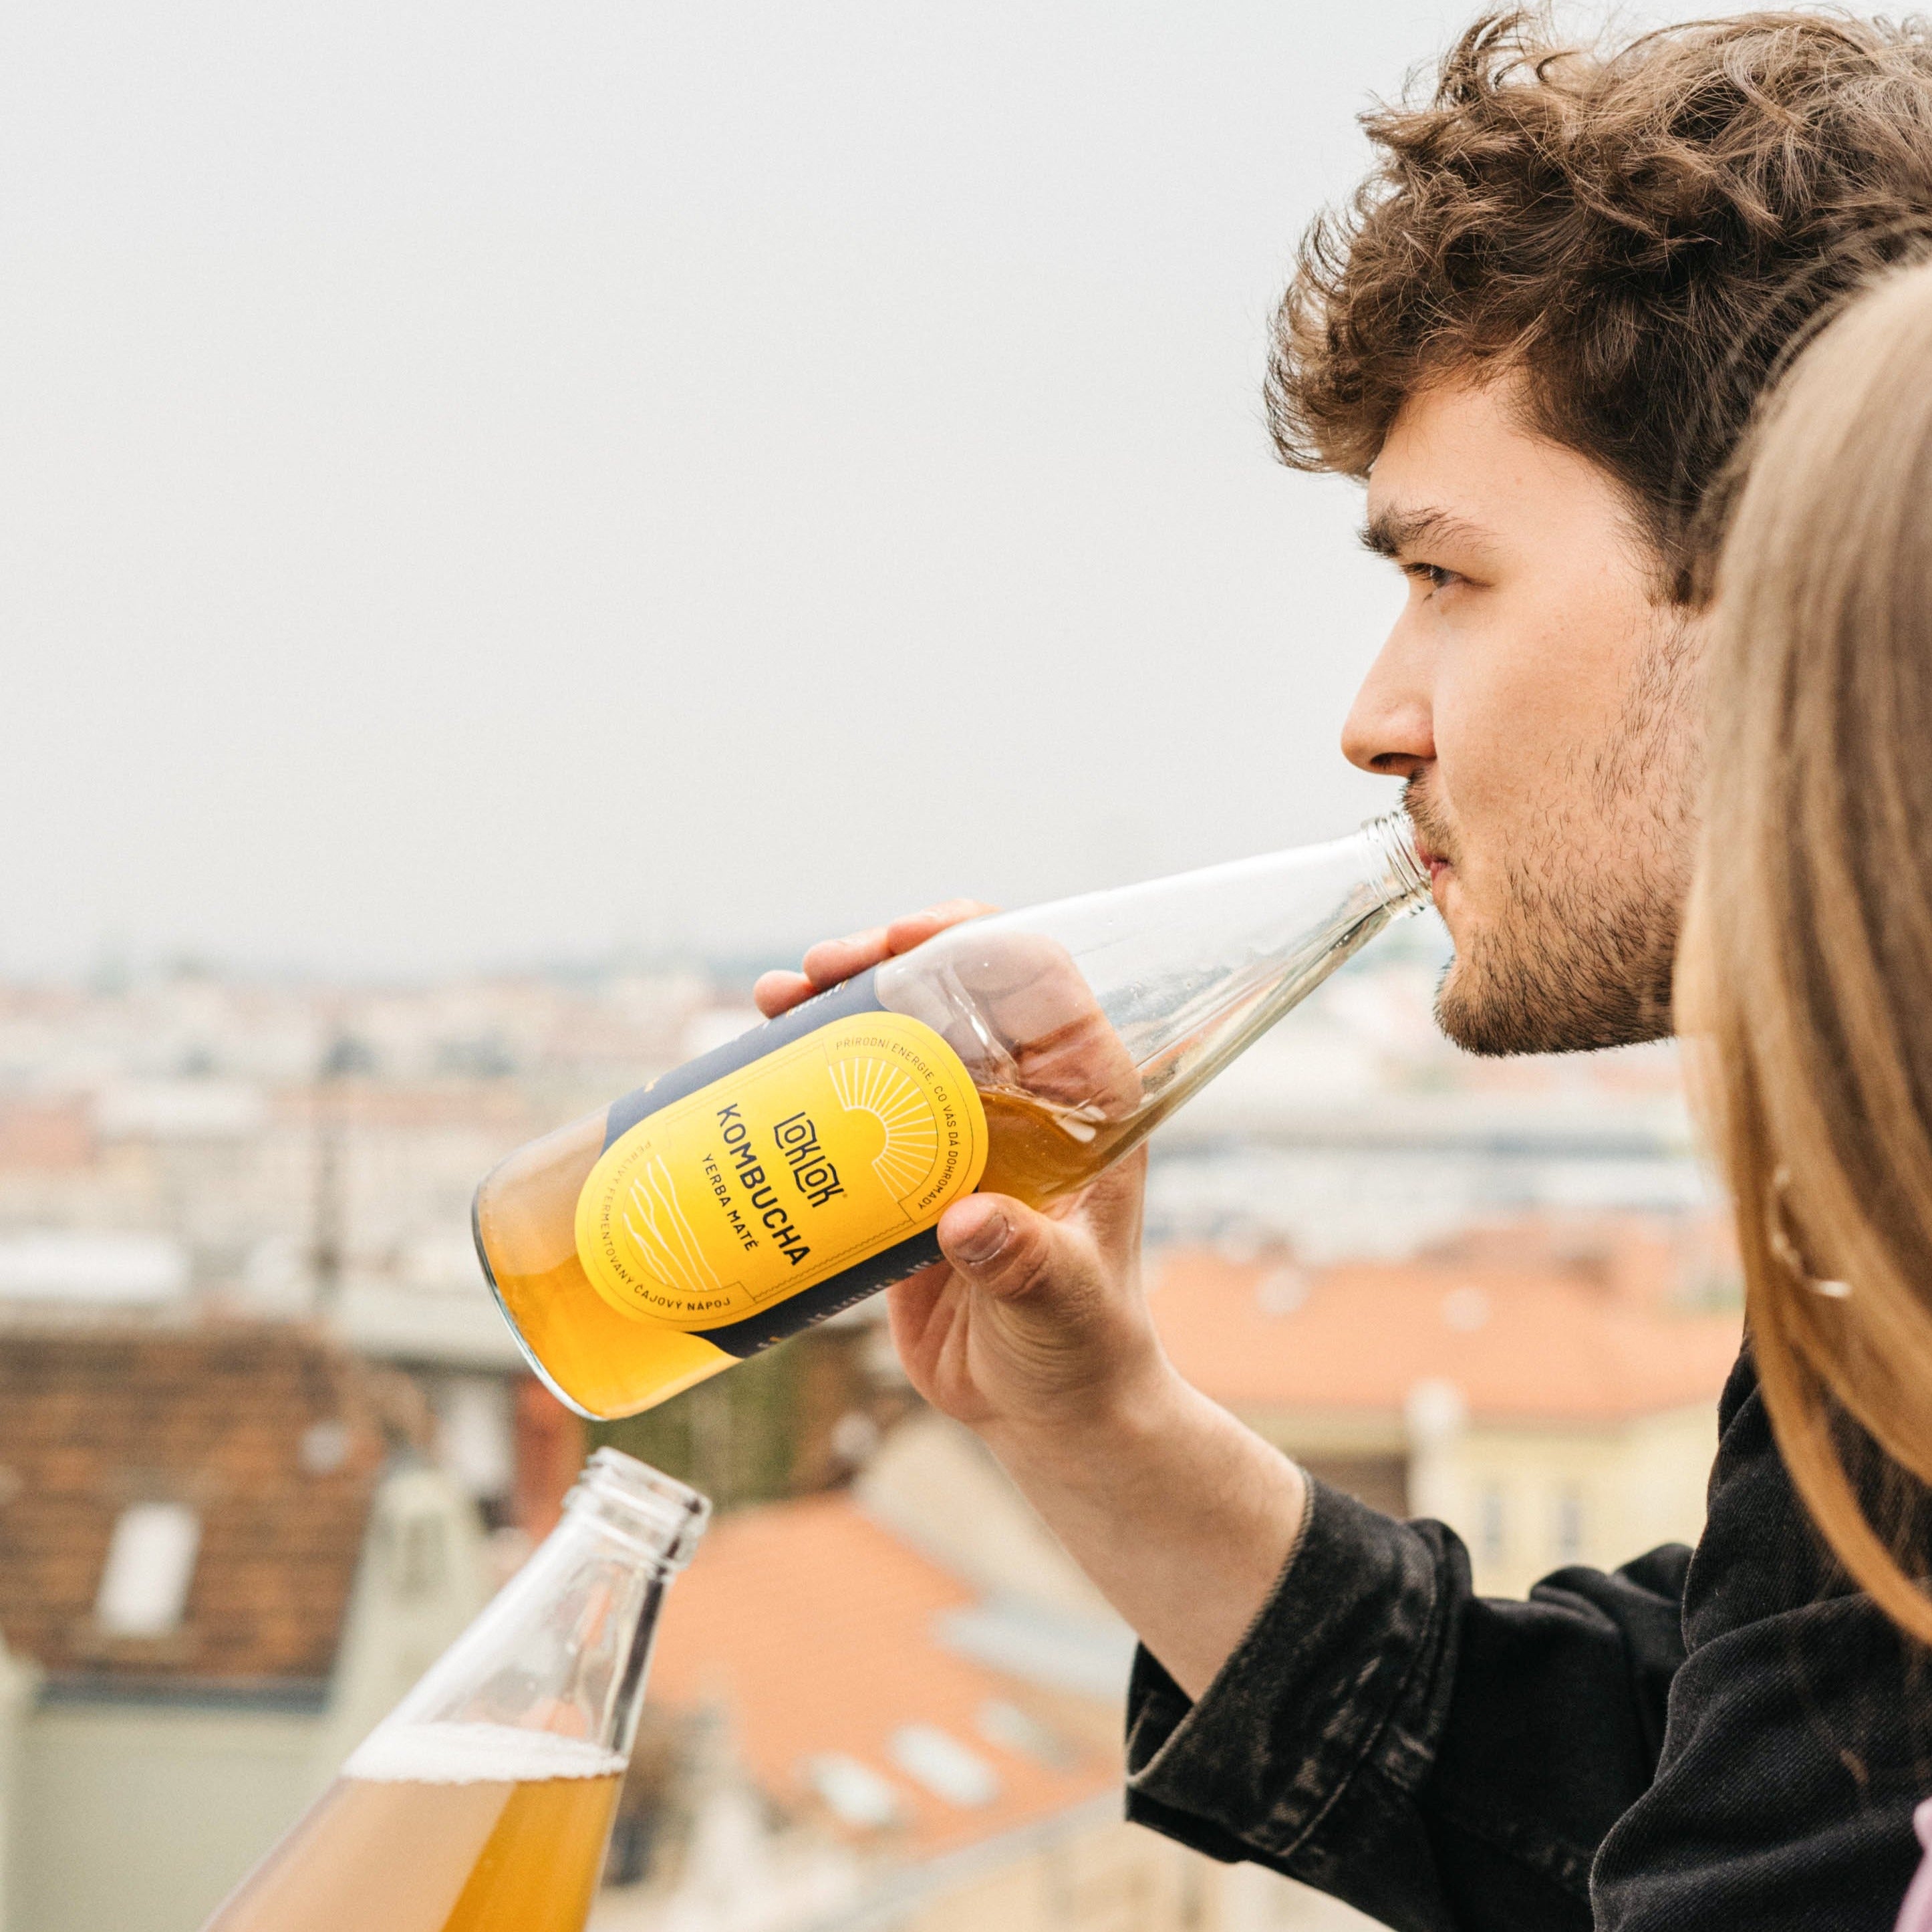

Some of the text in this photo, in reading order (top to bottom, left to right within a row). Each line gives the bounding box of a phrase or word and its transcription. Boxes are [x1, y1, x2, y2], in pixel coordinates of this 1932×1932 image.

[934, 1086, 947, 1101] CO
[943, 1105, 956, 1127] VÁS
[948, 1131, 960, 1146] DÁ
[716, 1103, 811, 1266] KOMBUCHA
[918, 1151, 958, 1210] DOHROMADY
[702, 1153, 759, 1251] YERBA MATÉ
